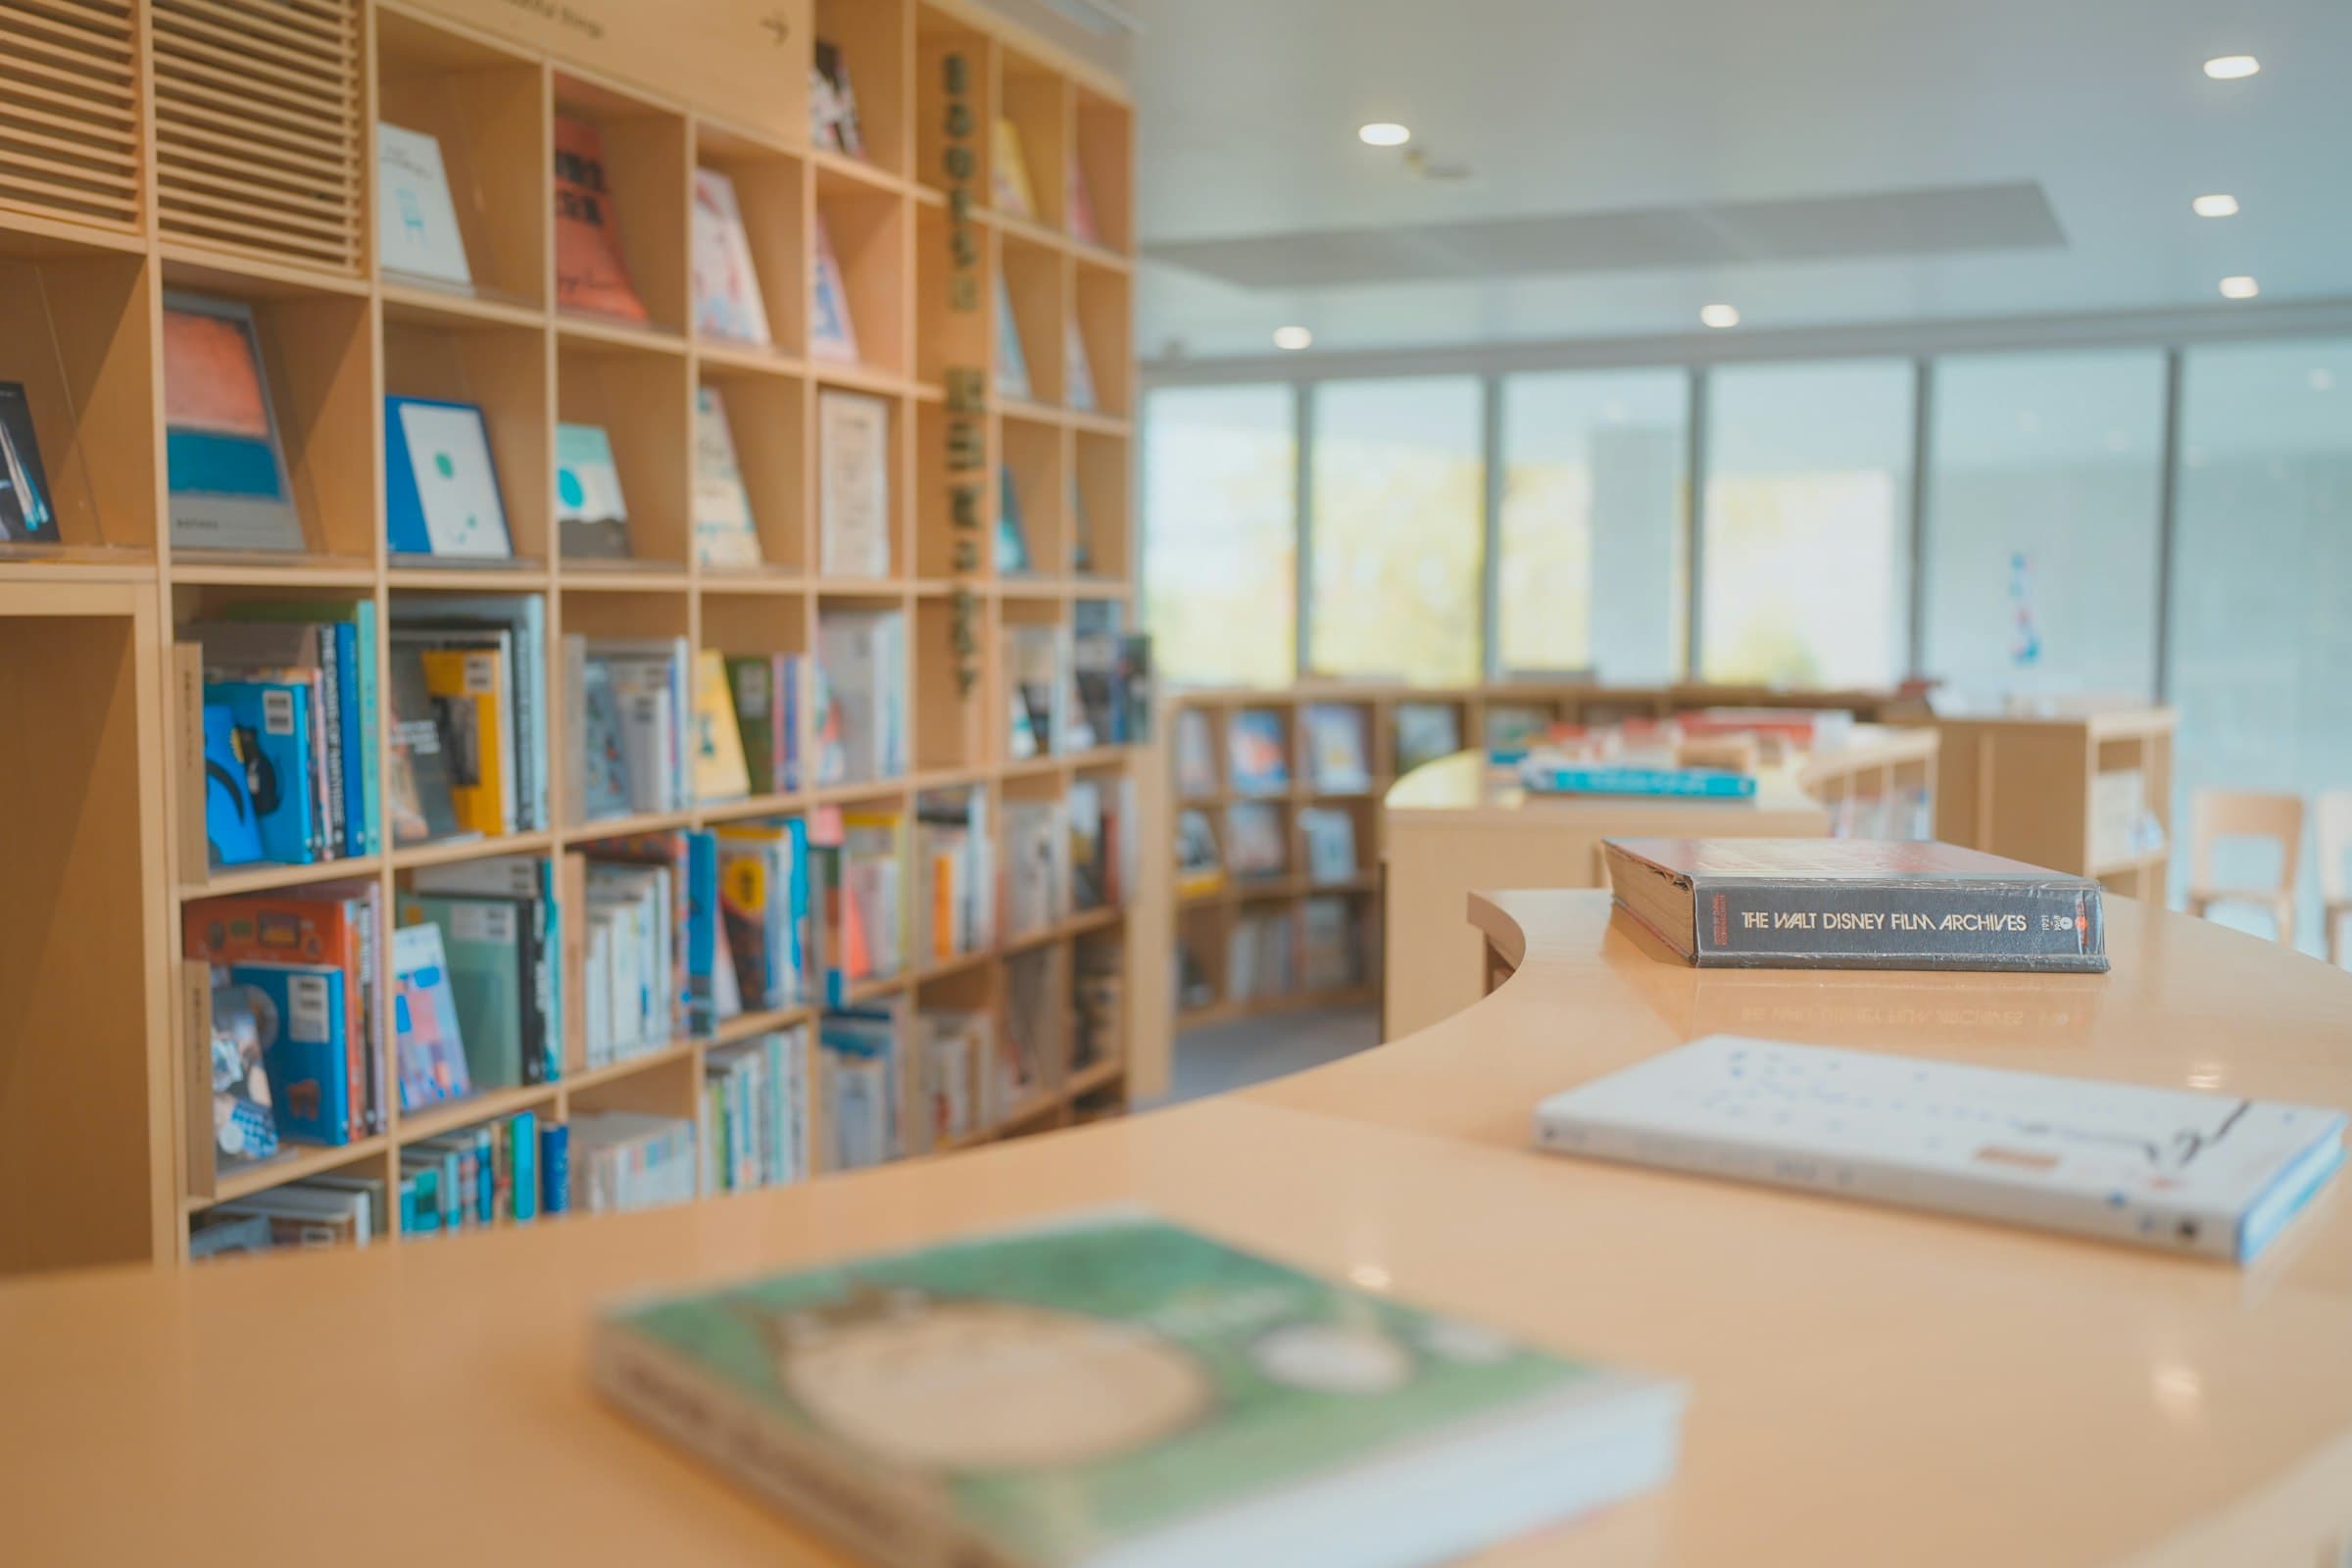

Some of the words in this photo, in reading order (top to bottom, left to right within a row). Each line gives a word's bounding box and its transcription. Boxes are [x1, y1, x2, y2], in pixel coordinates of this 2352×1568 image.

[1741, 911, 1769, 929] THE
[1774, 911, 1817, 929] WALT
[1823, 912, 1886, 930] DISNEY
[1891, 912, 1936, 931] FILM
[1938, 913, 2028, 932] ARCHIVES
[2041, 914, 2050, 931] 1921
